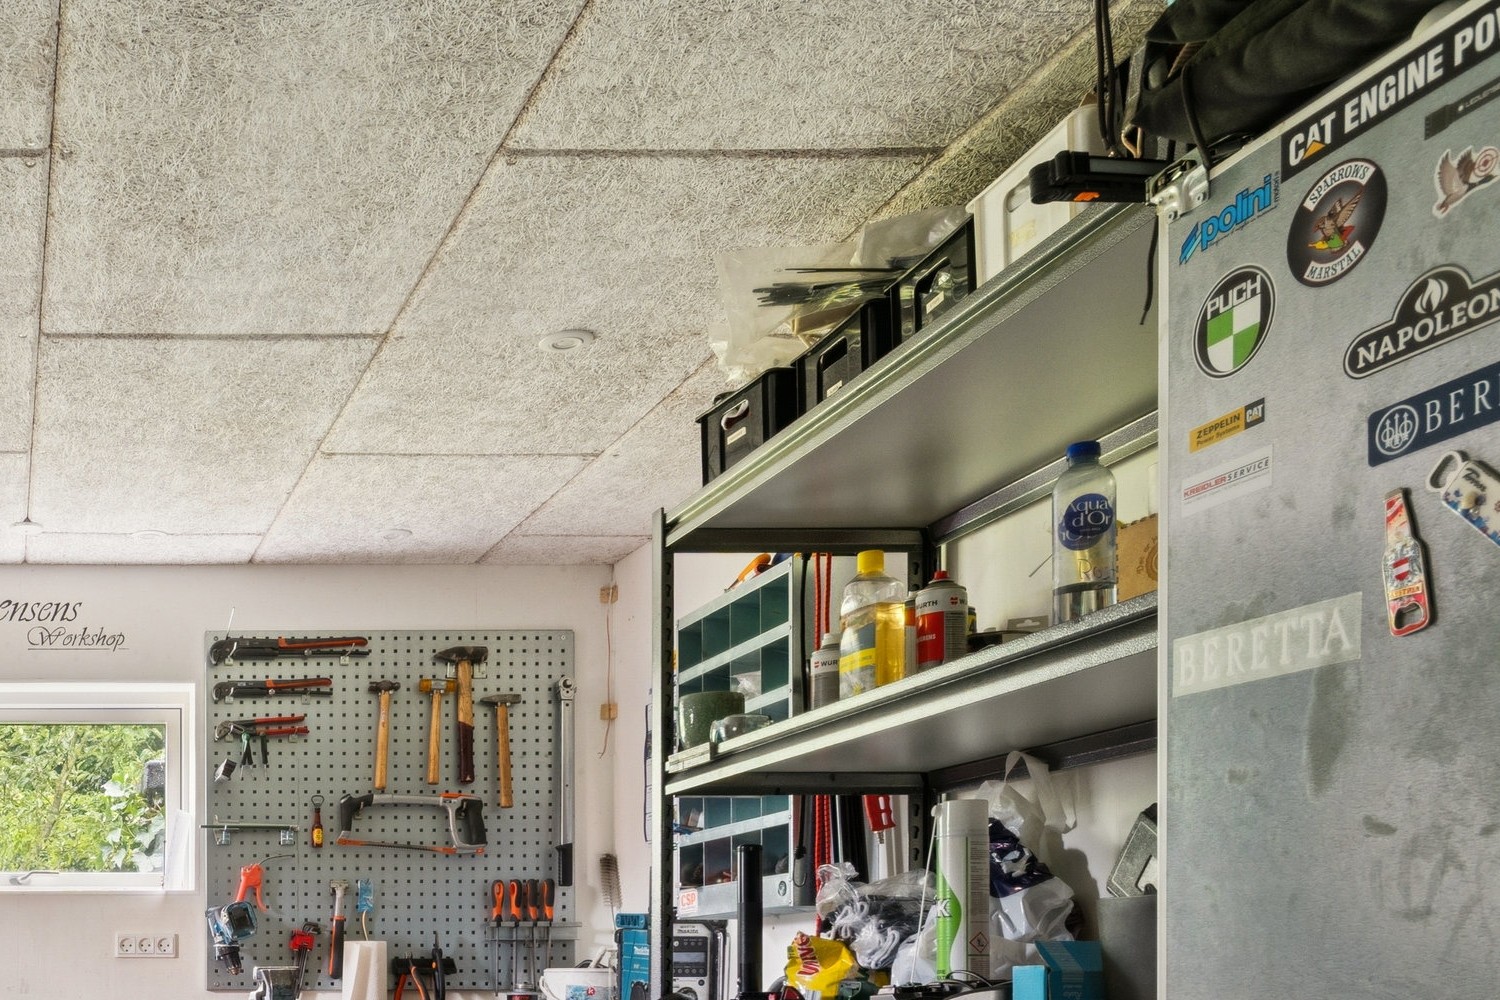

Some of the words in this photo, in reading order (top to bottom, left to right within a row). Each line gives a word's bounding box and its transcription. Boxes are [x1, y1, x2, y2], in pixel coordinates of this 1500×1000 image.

[1288, 111, 1337, 167] CAT
[1344, 43, 1444, 135] ENGINE
[1454, 7, 1500, 67] PO
[1309, 163, 1370, 205] SPARROWS
[1201, 173, 1272, 252] polini
[1306, 246, 1362, 280] MARSTAL
[1207, 273, 1261, 321] PUCH
[1196, 413, 1241, 440] ZEPPELIN
[1246, 404, 1264, 423] CAT
[1424, 374, 1500, 434] BER
[26, 626, 126, 652] Workshop
[1179, 606, 1354, 688] BERETTA
[681, 892, 696, 907] CSP
